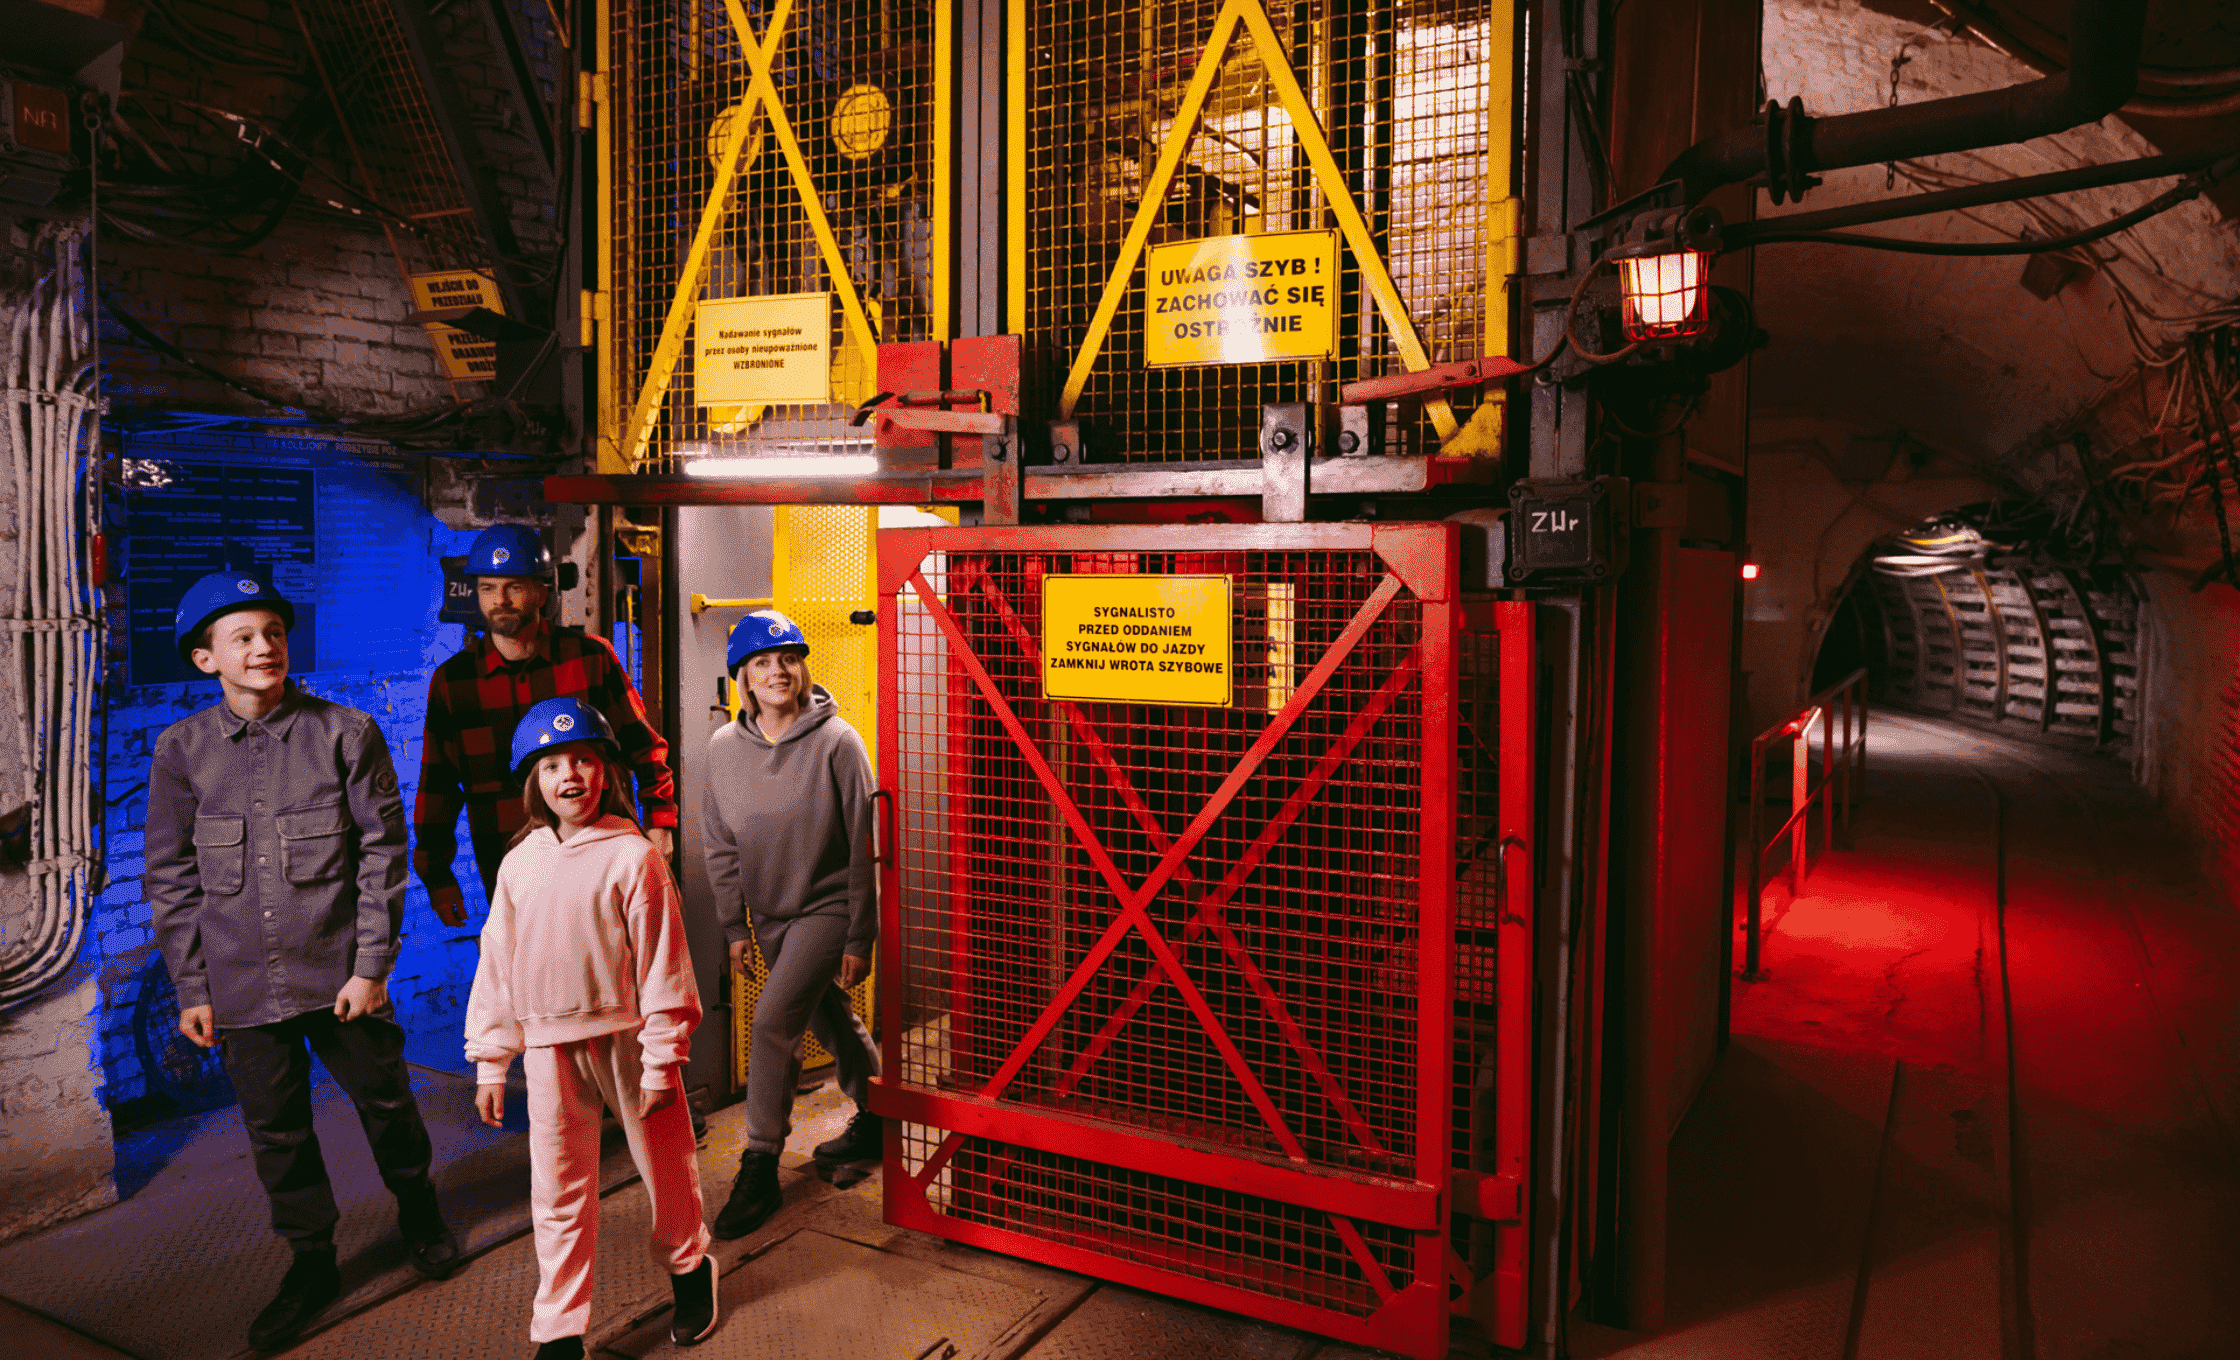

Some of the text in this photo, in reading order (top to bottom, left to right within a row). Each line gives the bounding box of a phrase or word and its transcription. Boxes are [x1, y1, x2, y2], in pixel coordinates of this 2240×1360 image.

[1161, 257, 1320, 286] UWAGA SZYB !
[466, 279, 480, 290] DO
[1156, 283, 1325, 313] ZACHOWAĆ SIĘ
[718, 326, 803, 339] Nadawanie sygnałów
[1174, 312, 1302, 339] OSTRŻNIE
[451, 346, 494, 360] DRABINO
[705, 342, 818, 357] przez osoby nieupoważnione
[733, 359, 785, 369] WZBRONIONE
[1531, 510, 1579, 533] ZWr
[1093, 606, 1176, 619] SYGNALISTO
[1078, 624, 1192, 637] PRZED ODDANIEM
[1066, 640, 1206, 655] SYGNAŁÓW DO JAZDY
[1050, 658, 1224, 674] ZAMKNIJ WROTA SZYBOWE
